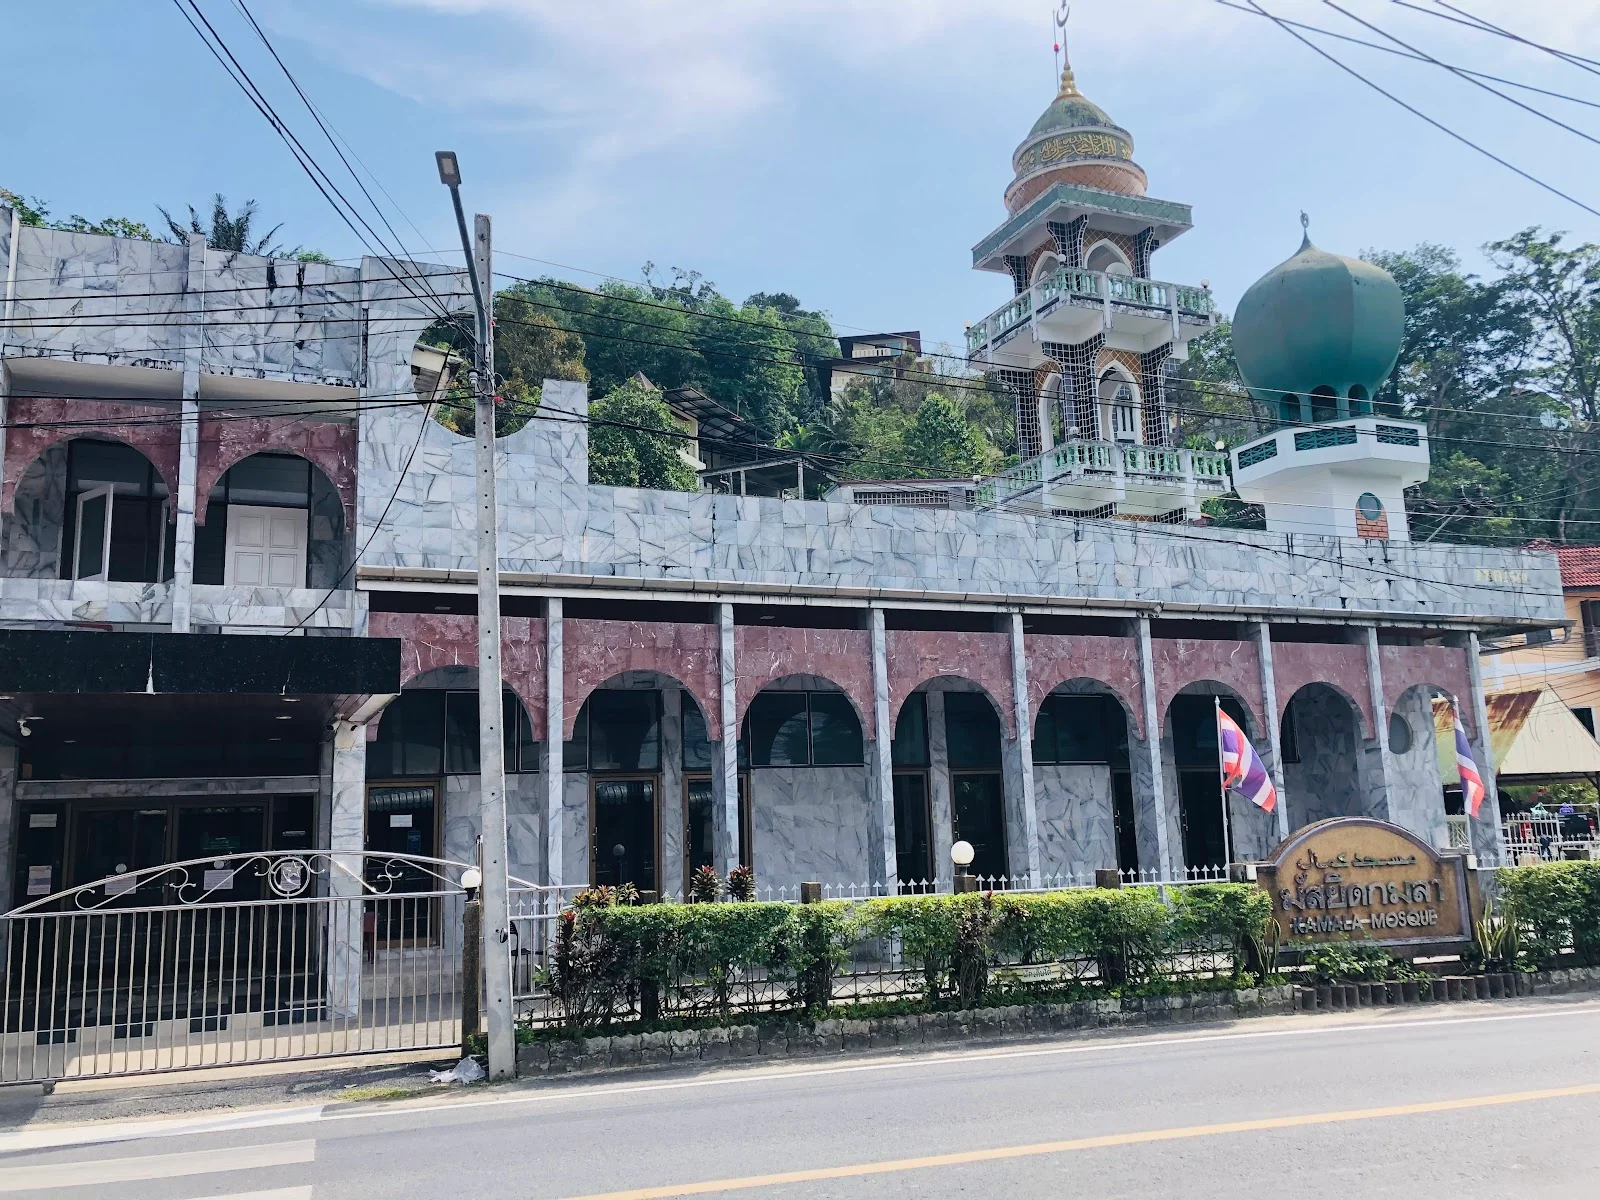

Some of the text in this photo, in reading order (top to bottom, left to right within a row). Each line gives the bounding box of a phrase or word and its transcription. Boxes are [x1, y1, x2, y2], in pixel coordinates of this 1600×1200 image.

[1352, 853, 1417, 868] مسجد
[1280, 871, 1444, 911] มัสยิดกมลา
[1291, 908, 1438, 934] KAMALA MOSQUE
